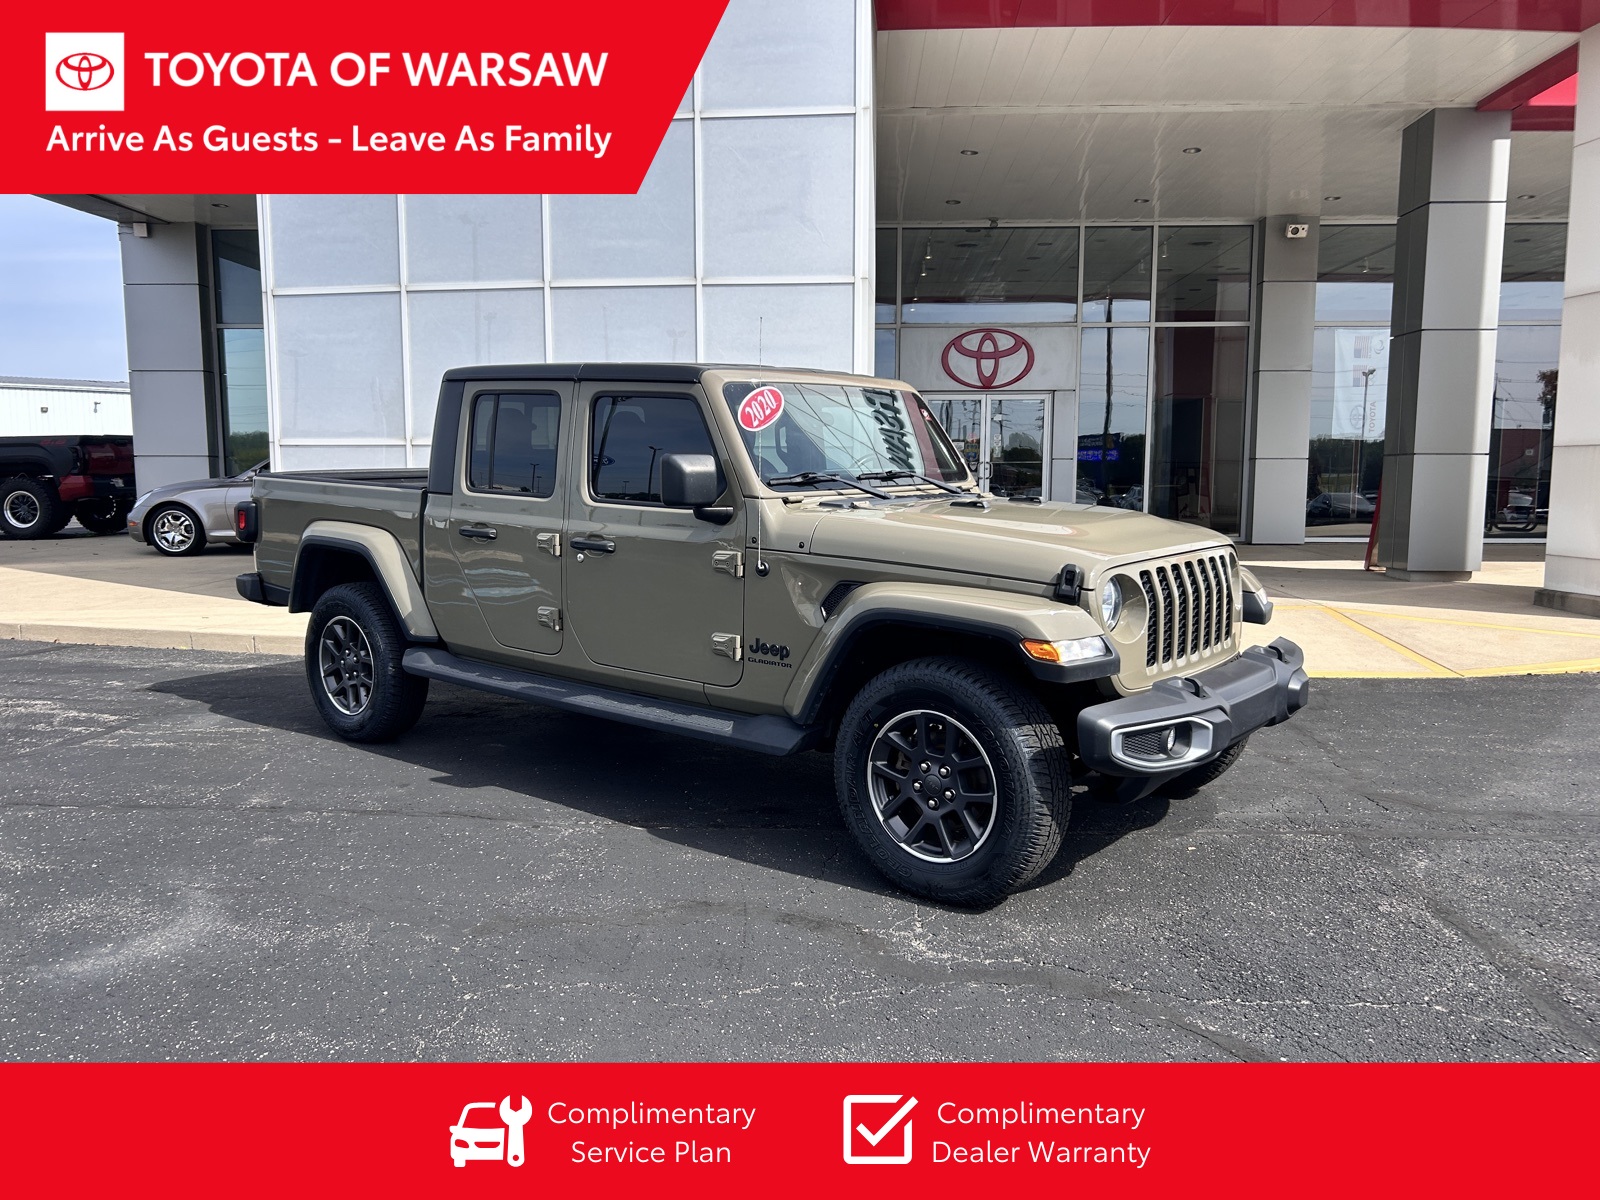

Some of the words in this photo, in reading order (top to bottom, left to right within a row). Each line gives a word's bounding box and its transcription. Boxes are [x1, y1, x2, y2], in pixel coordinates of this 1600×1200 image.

[744, 389, 777, 428] 2020
[1368, 401, 1377, 433] TOYOTA
[747, 656, 793, 669] GLADIATOR
[749, 637, 790, 661] Jeep
